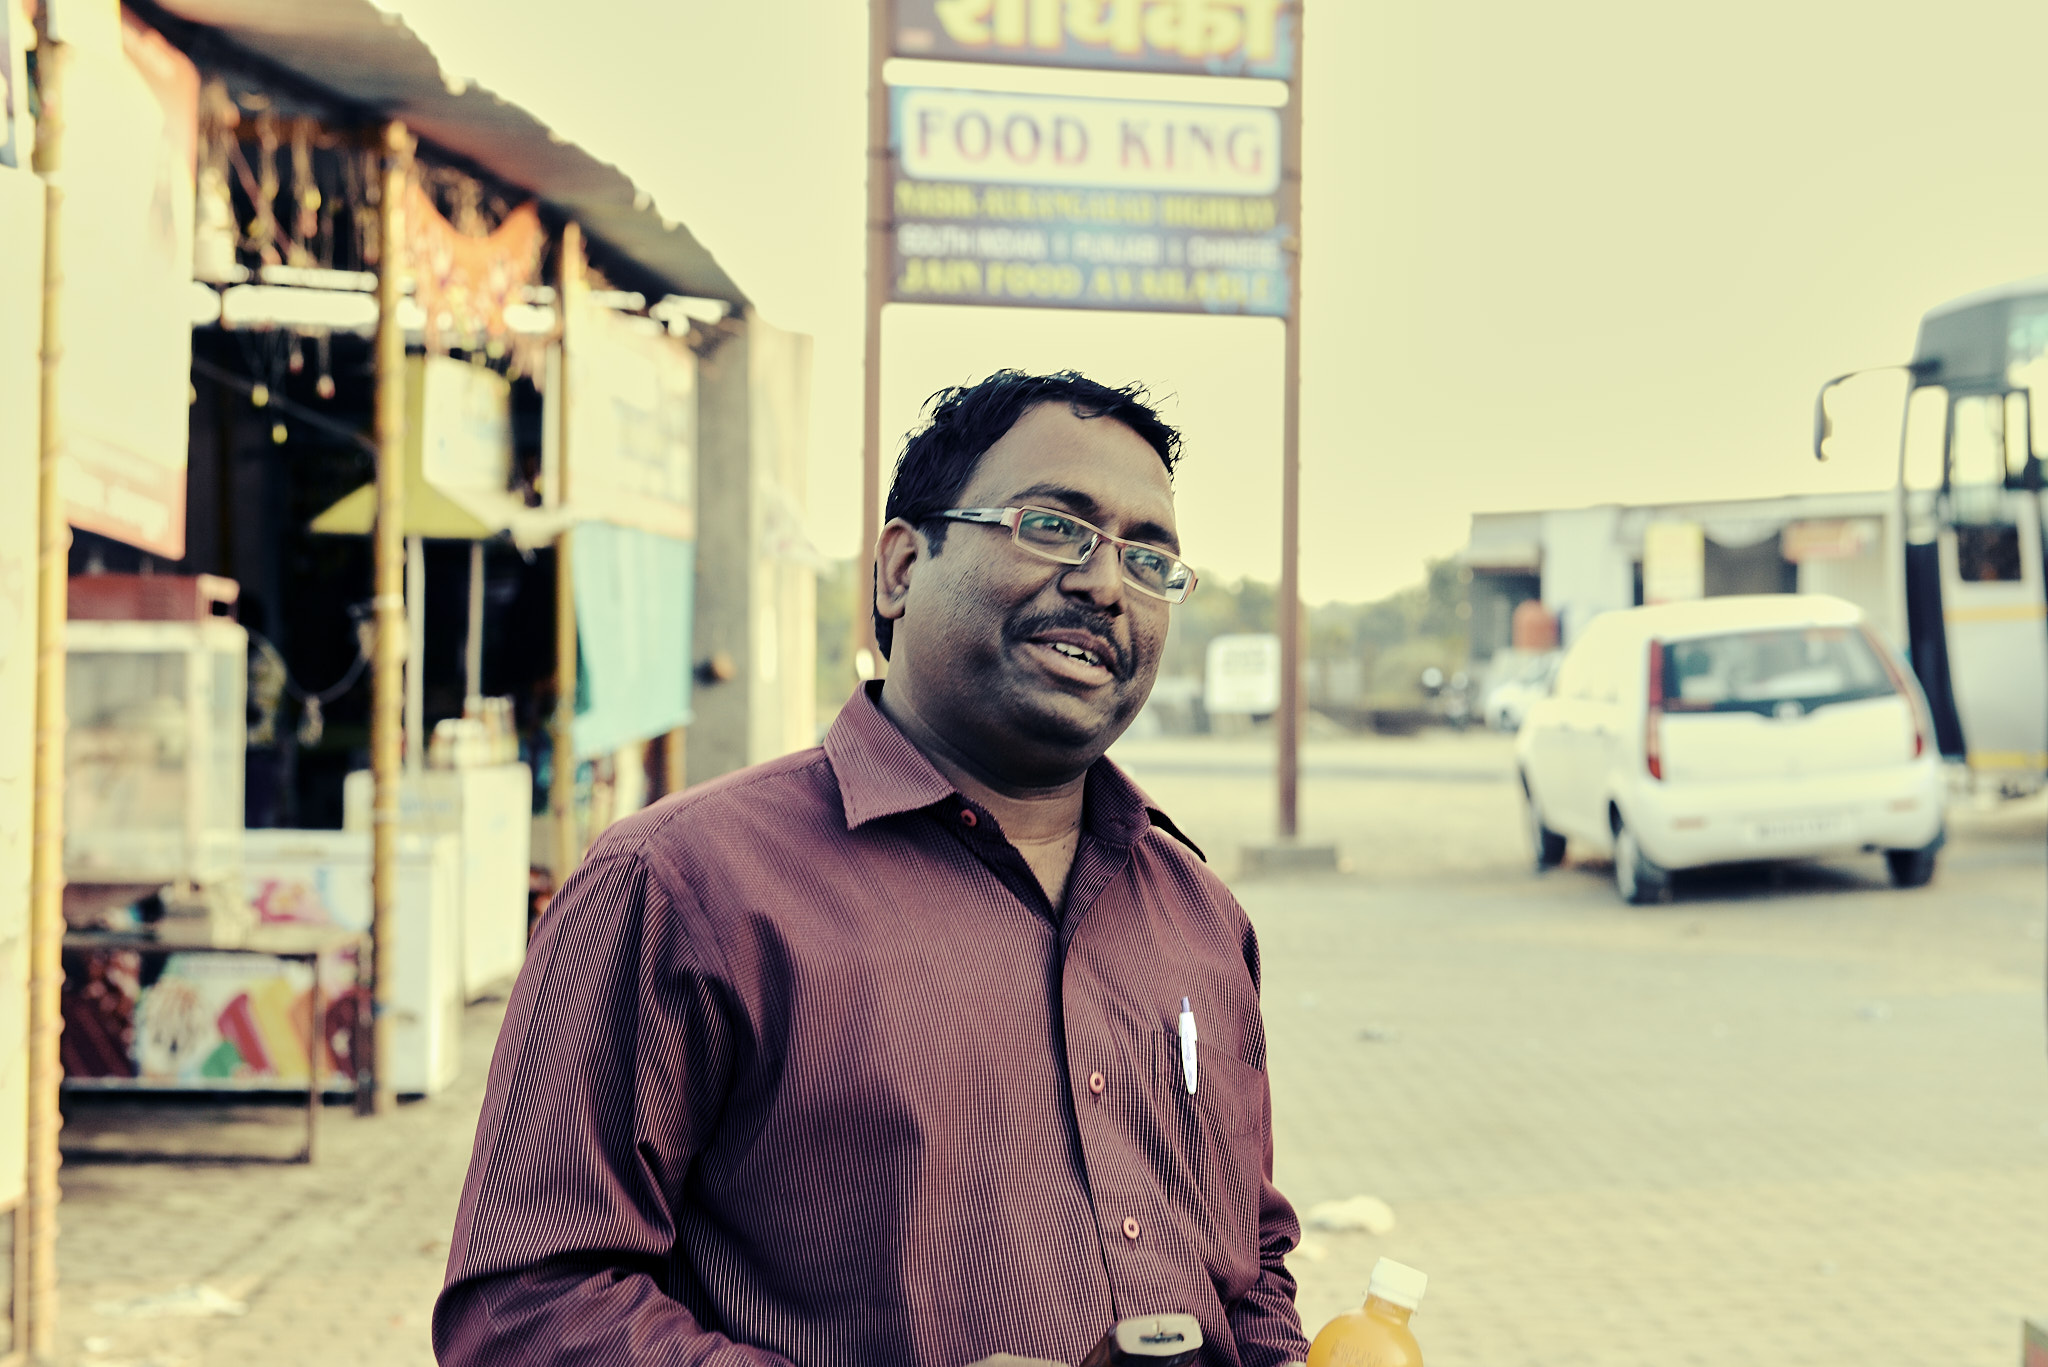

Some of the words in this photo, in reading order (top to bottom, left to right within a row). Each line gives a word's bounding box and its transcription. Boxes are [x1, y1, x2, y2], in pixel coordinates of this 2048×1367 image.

[915, 109, 1090, 167] FOOD
[1117, 117, 1264, 176] KING
[899, 259, 980, 293] JAIN
[987, 262, 1082, 297] FOOD
[1088, 266, 1273, 303] AVAILABLE
